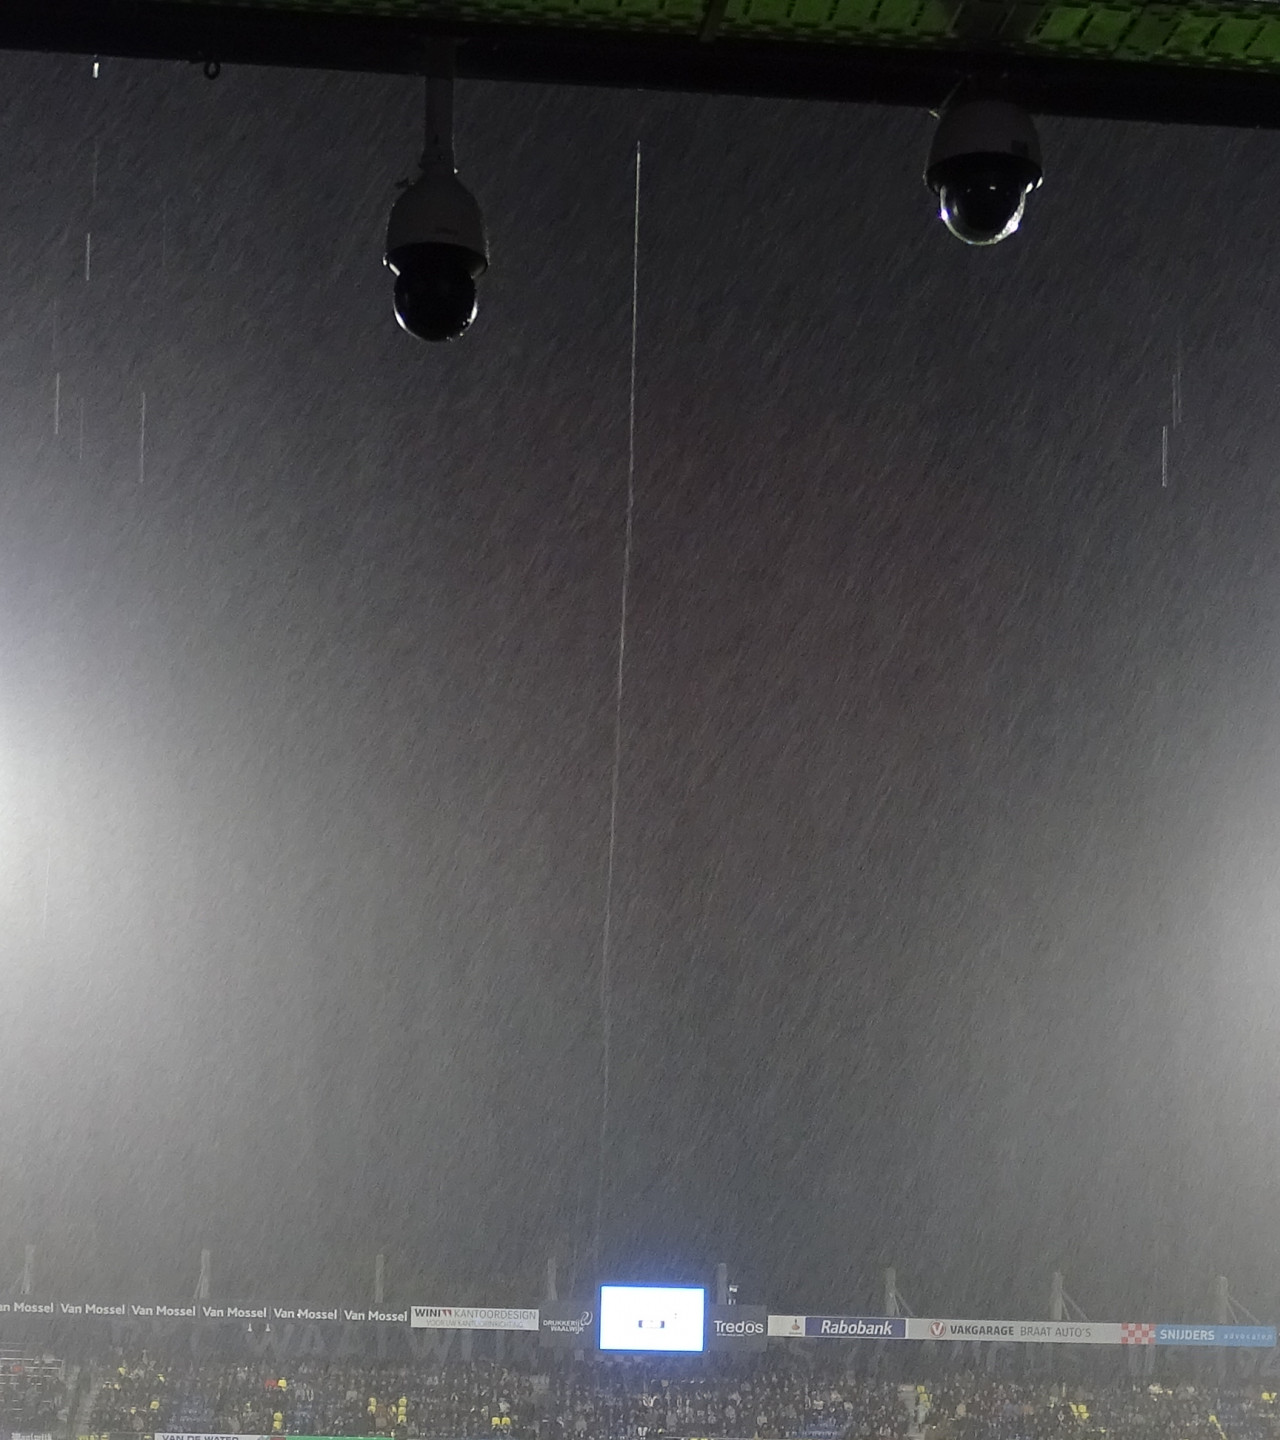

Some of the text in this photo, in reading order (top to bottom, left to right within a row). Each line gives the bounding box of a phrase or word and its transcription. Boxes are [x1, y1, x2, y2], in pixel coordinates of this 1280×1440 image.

[14, 1302, 53, 1313] Mossel
[61, 1304, 125, 1315] Van Mossel
[131, 1305, 195, 1316] Van Mossel
[202, 1307, 266, 1318] Van Mossel
[274, 1308, 337, 1320] Van Mossel
[344, 1310, 407, 1322] Van Mossel
[415, 1308, 536, 1320] WINI KANTOORDESIGN
[551, 1325, 584, 1334] WAALWIJK
[714, 1320, 764, 1334] Tredos
[821, 1319, 892, 1336] Rabobank
[950, 1325, 1091, 1338] VAKGARAGE BRAAT AUTO'S
[1160, 1330, 1215, 1341] SNIJDERS
